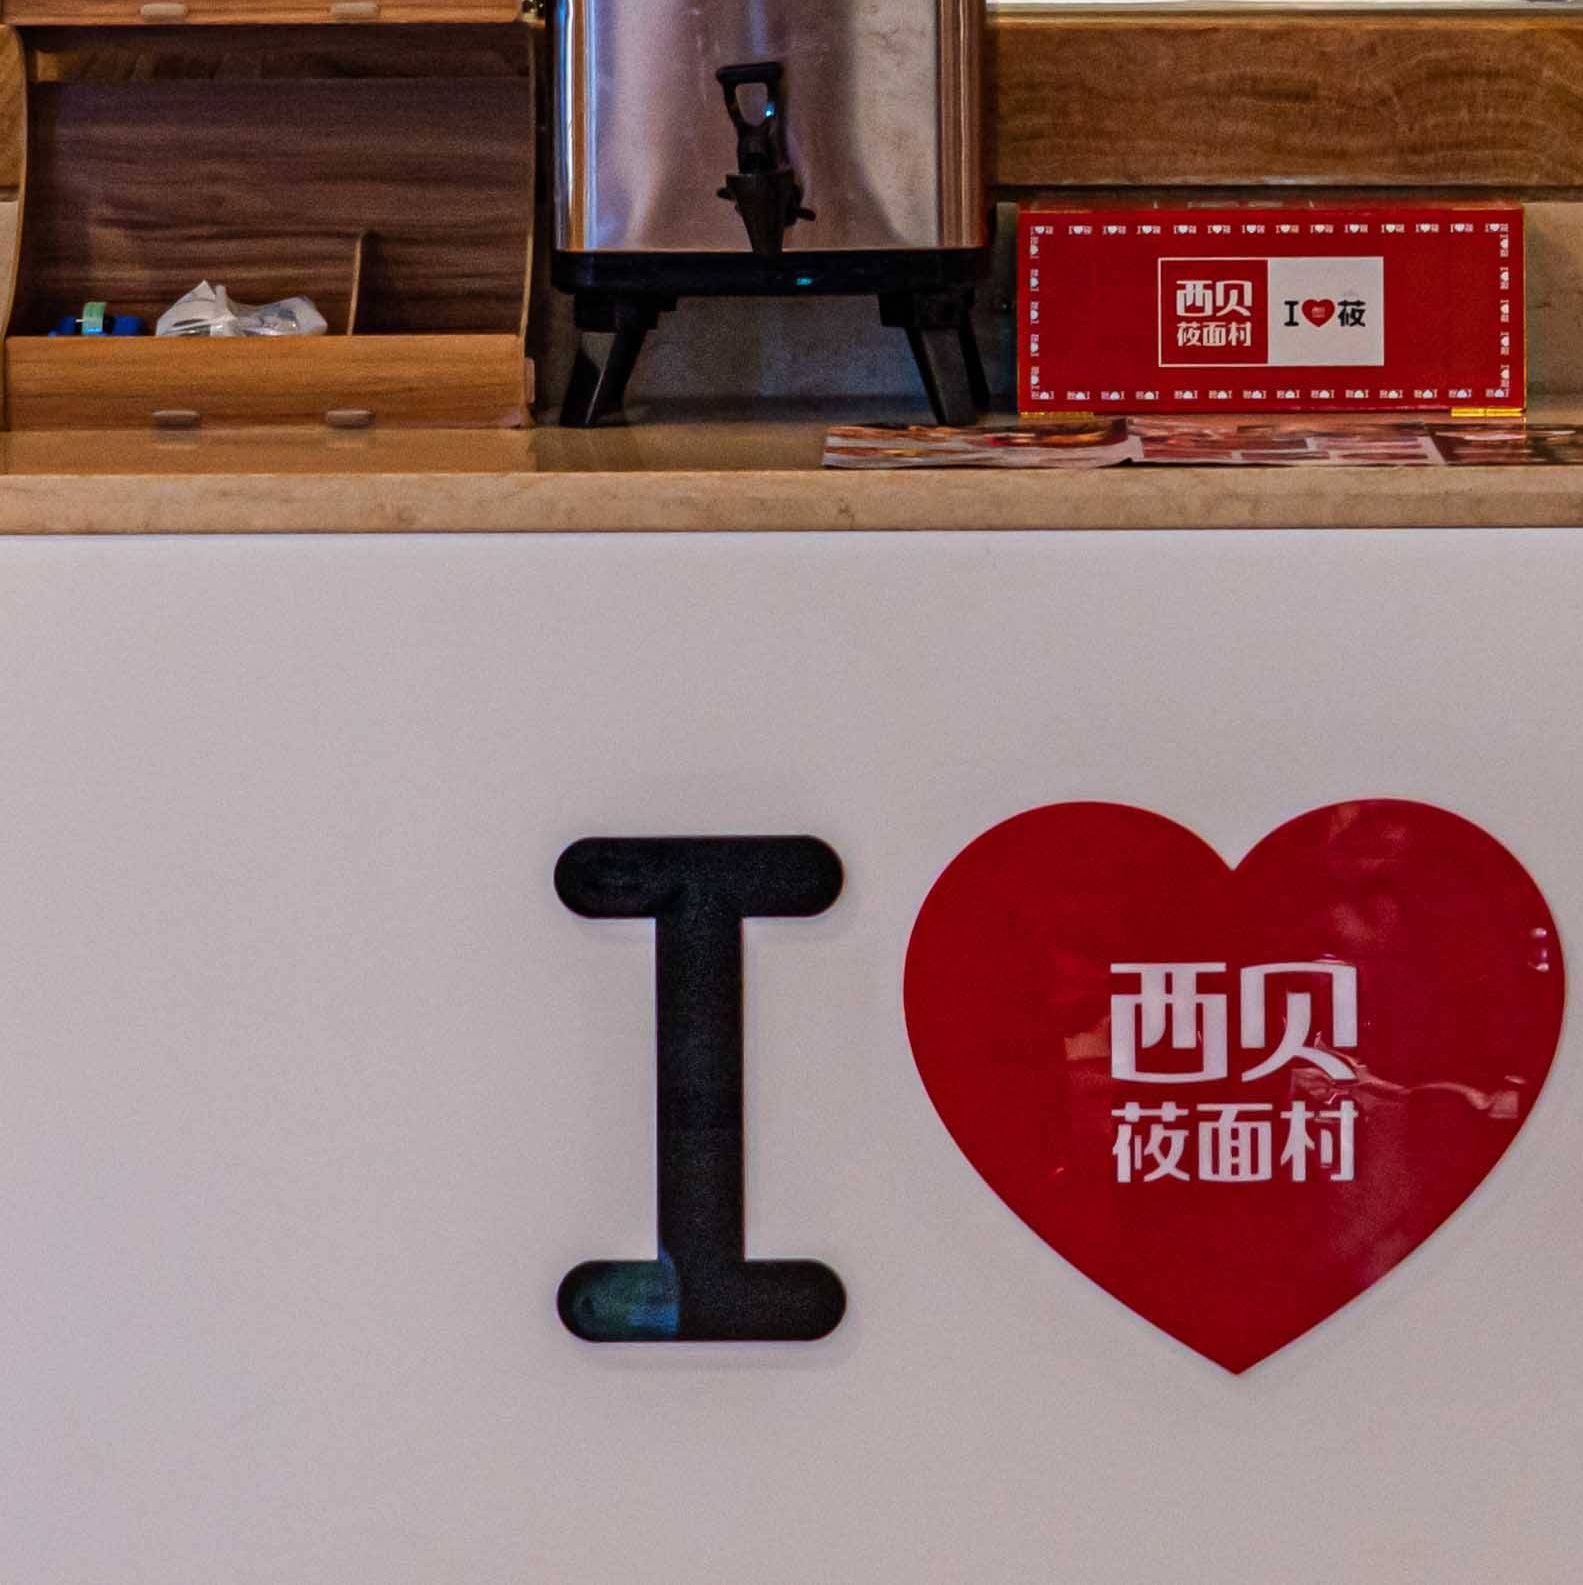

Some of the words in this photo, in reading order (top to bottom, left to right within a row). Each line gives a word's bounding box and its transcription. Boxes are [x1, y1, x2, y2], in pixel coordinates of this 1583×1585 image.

[1176, 279, 1253, 317] 西贝
[1284, 300, 1299, 327] I
[1176, 321, 1252, 347] 莜面村
[1109, 960, 1361, 1084] 西贝
[553, 834, 848, 1344] I
[1110, 1098, 1359, 1184] 莜面村
